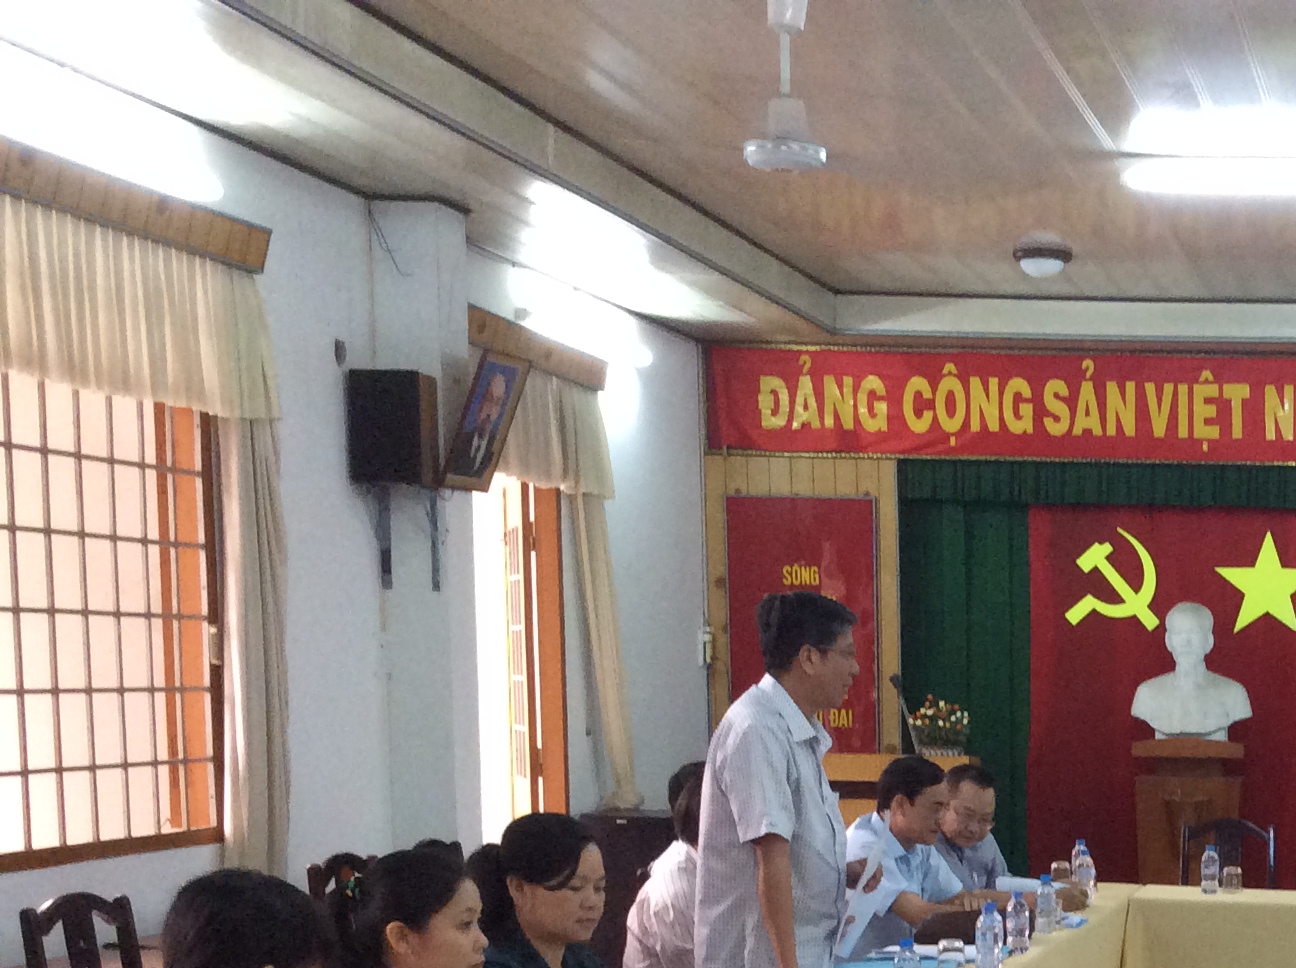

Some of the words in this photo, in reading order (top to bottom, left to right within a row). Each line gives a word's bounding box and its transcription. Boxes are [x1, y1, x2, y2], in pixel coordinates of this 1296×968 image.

[757, 354, 887, 432] ĐẢNG
[902, 362, 1034, 447] CỘNG
[1043, 358, 1136, 437] SẢN
[1144, 369, 1251, 452] VIỆT
